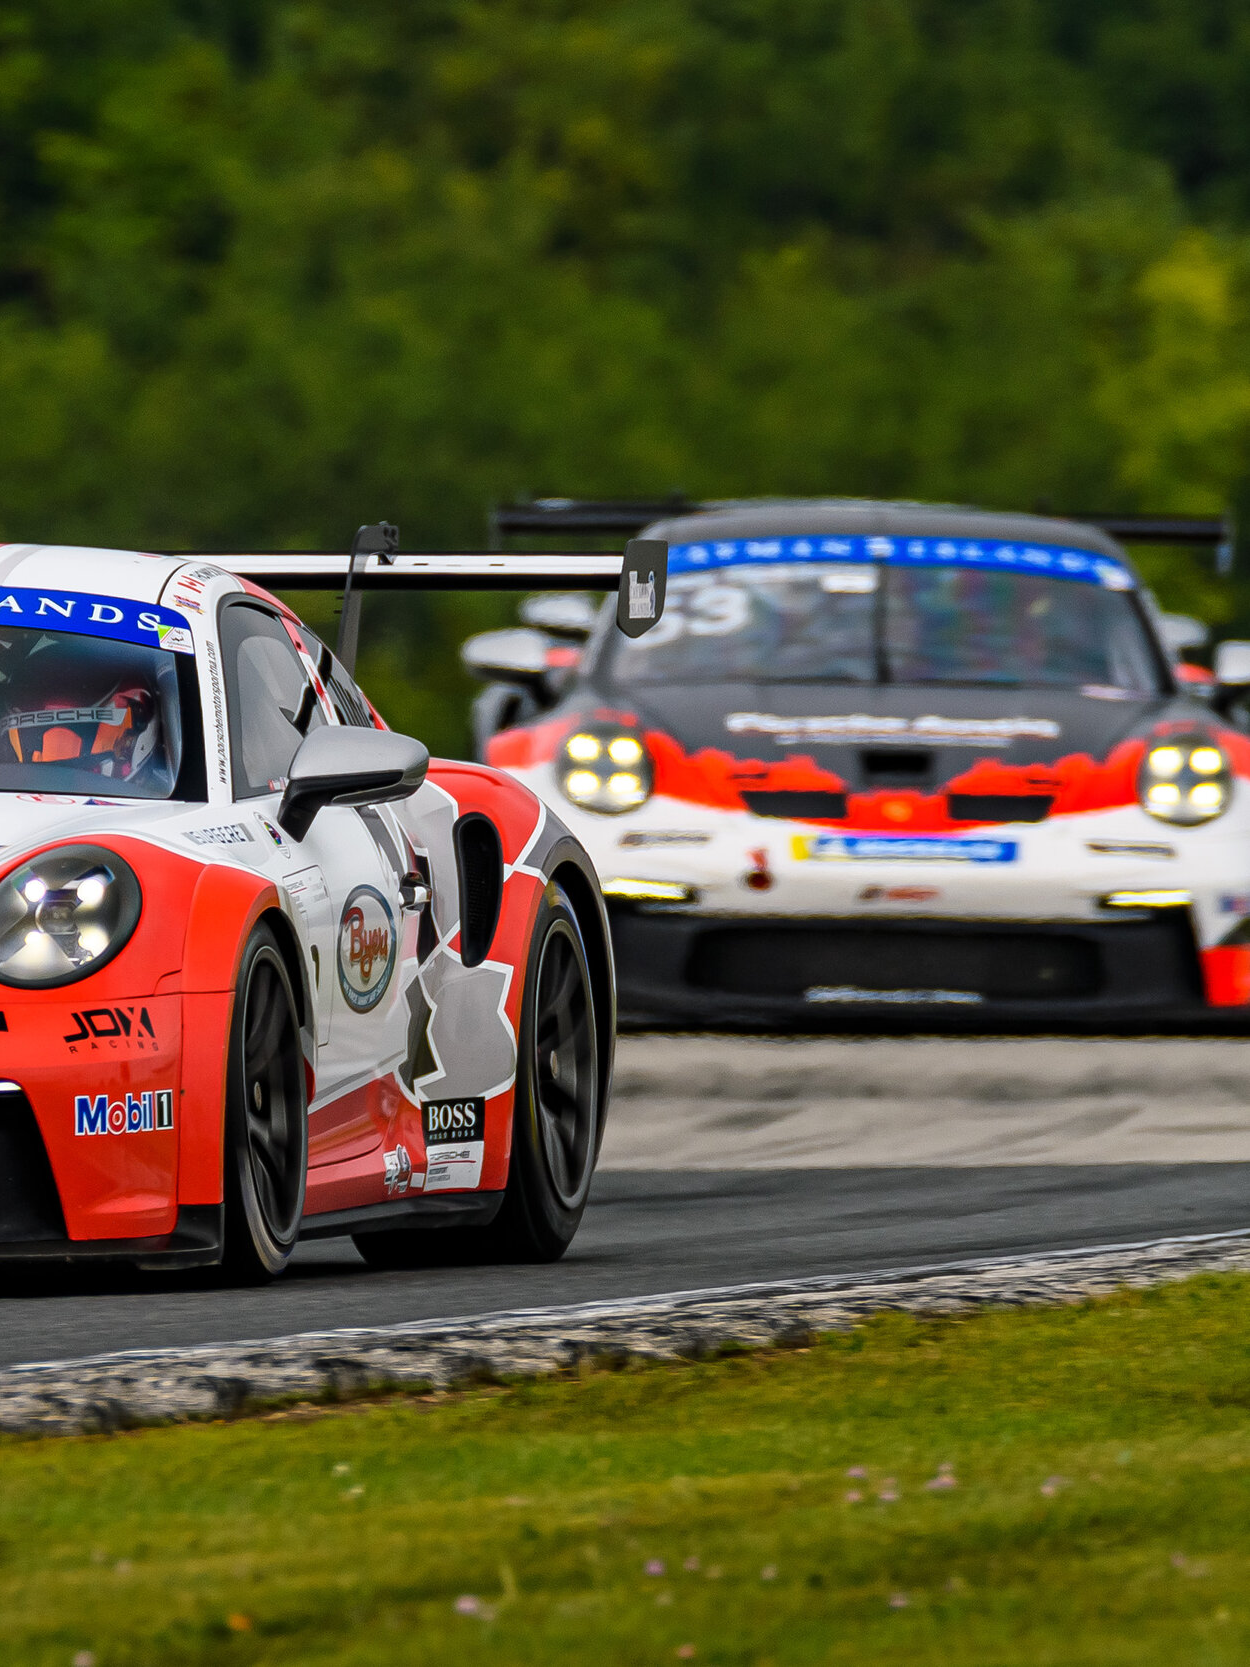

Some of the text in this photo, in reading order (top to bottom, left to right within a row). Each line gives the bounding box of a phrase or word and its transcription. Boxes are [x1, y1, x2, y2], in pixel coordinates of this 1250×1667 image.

[63, 1006, 156, 1043] JDX
[68, 1039, 159, 1054] RACING
[74, 1091, 154, 1136] Mobil
[428, 1102, 476, 1131] BOSS
